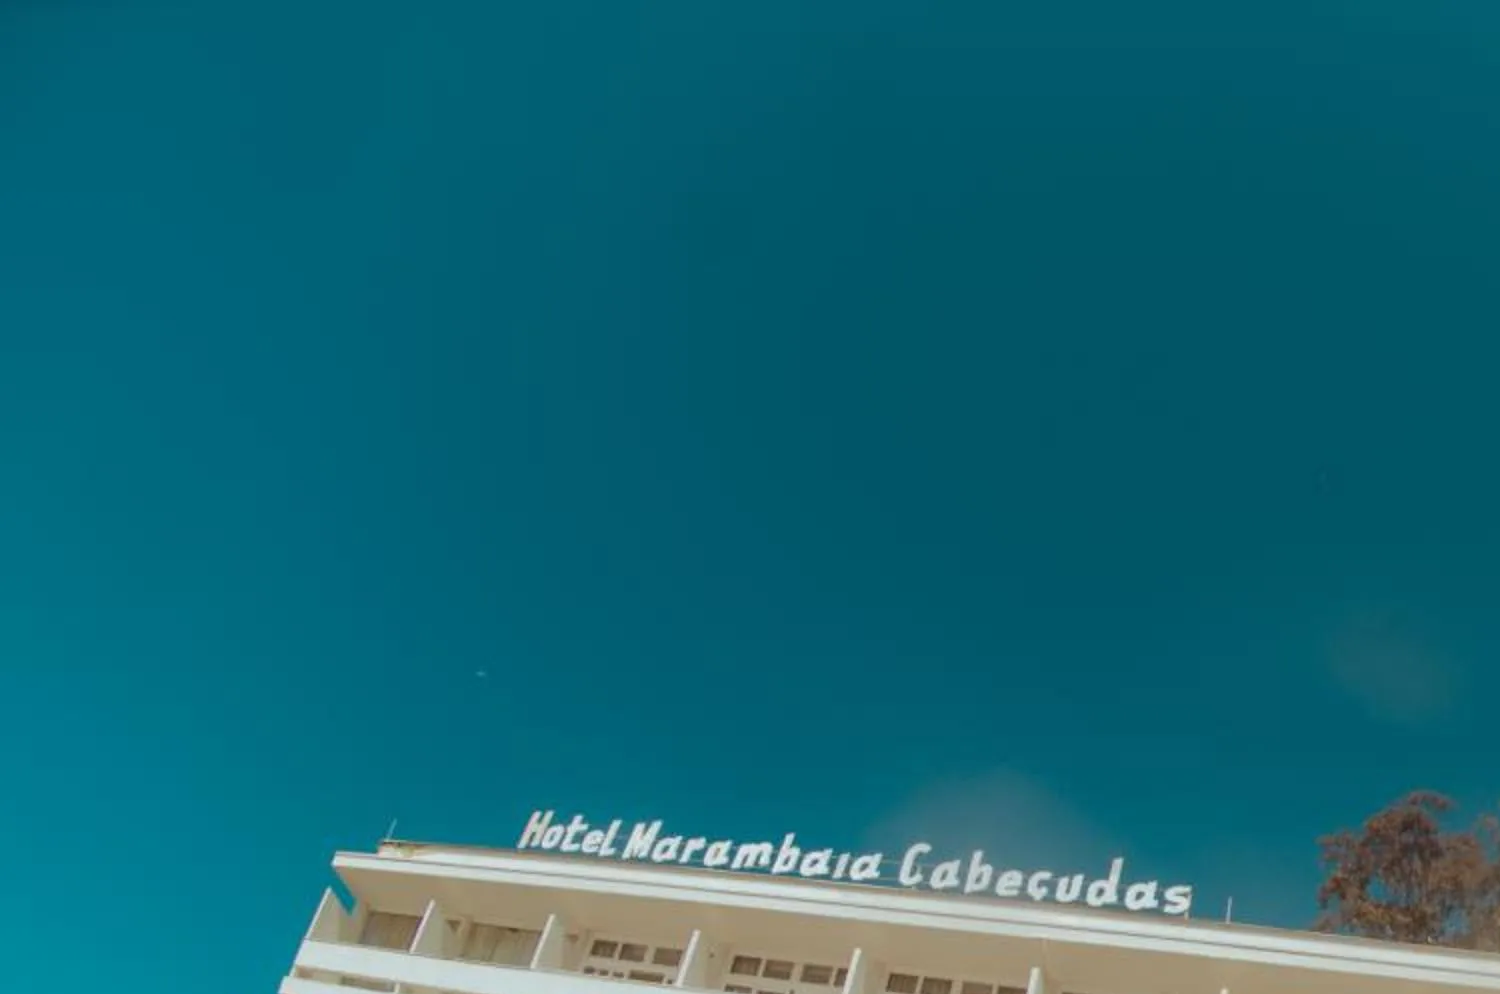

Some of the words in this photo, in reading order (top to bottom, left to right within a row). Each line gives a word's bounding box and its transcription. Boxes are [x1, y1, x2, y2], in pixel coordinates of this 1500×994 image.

[517, 809, 622, 857] Hotel
[621, 819, 883, 881] Marambaia
[899, 842, 1192, 914] Cabeçudas
